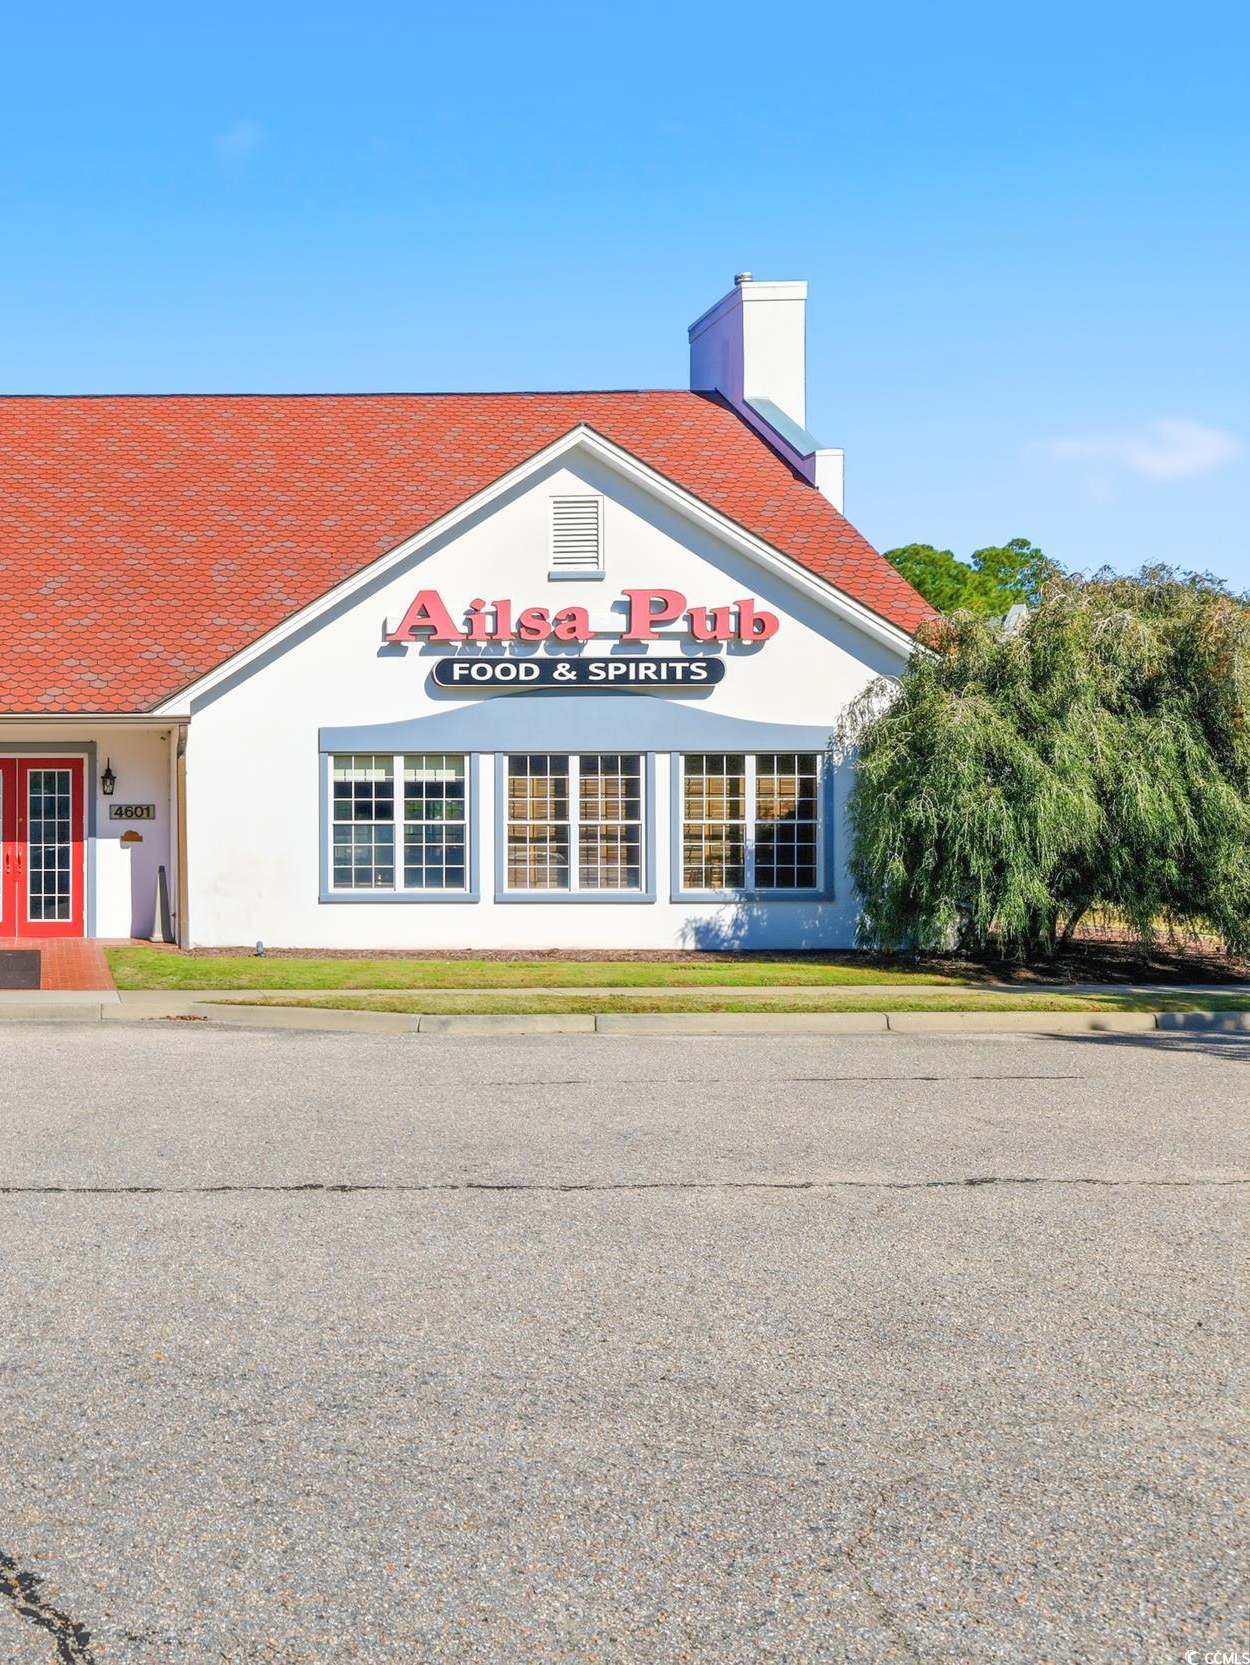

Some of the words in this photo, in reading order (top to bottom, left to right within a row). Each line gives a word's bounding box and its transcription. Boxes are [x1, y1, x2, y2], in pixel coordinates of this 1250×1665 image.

[386, 590, 595, 642] Ailsa
[621, 589, 780, 641] Pub
[453, 662, 540, 681] FOOD
[553, 662, 578, 681] &
[588, 662, 708, 681] SPIRITS
[113, 806, 150, 818] 4601
